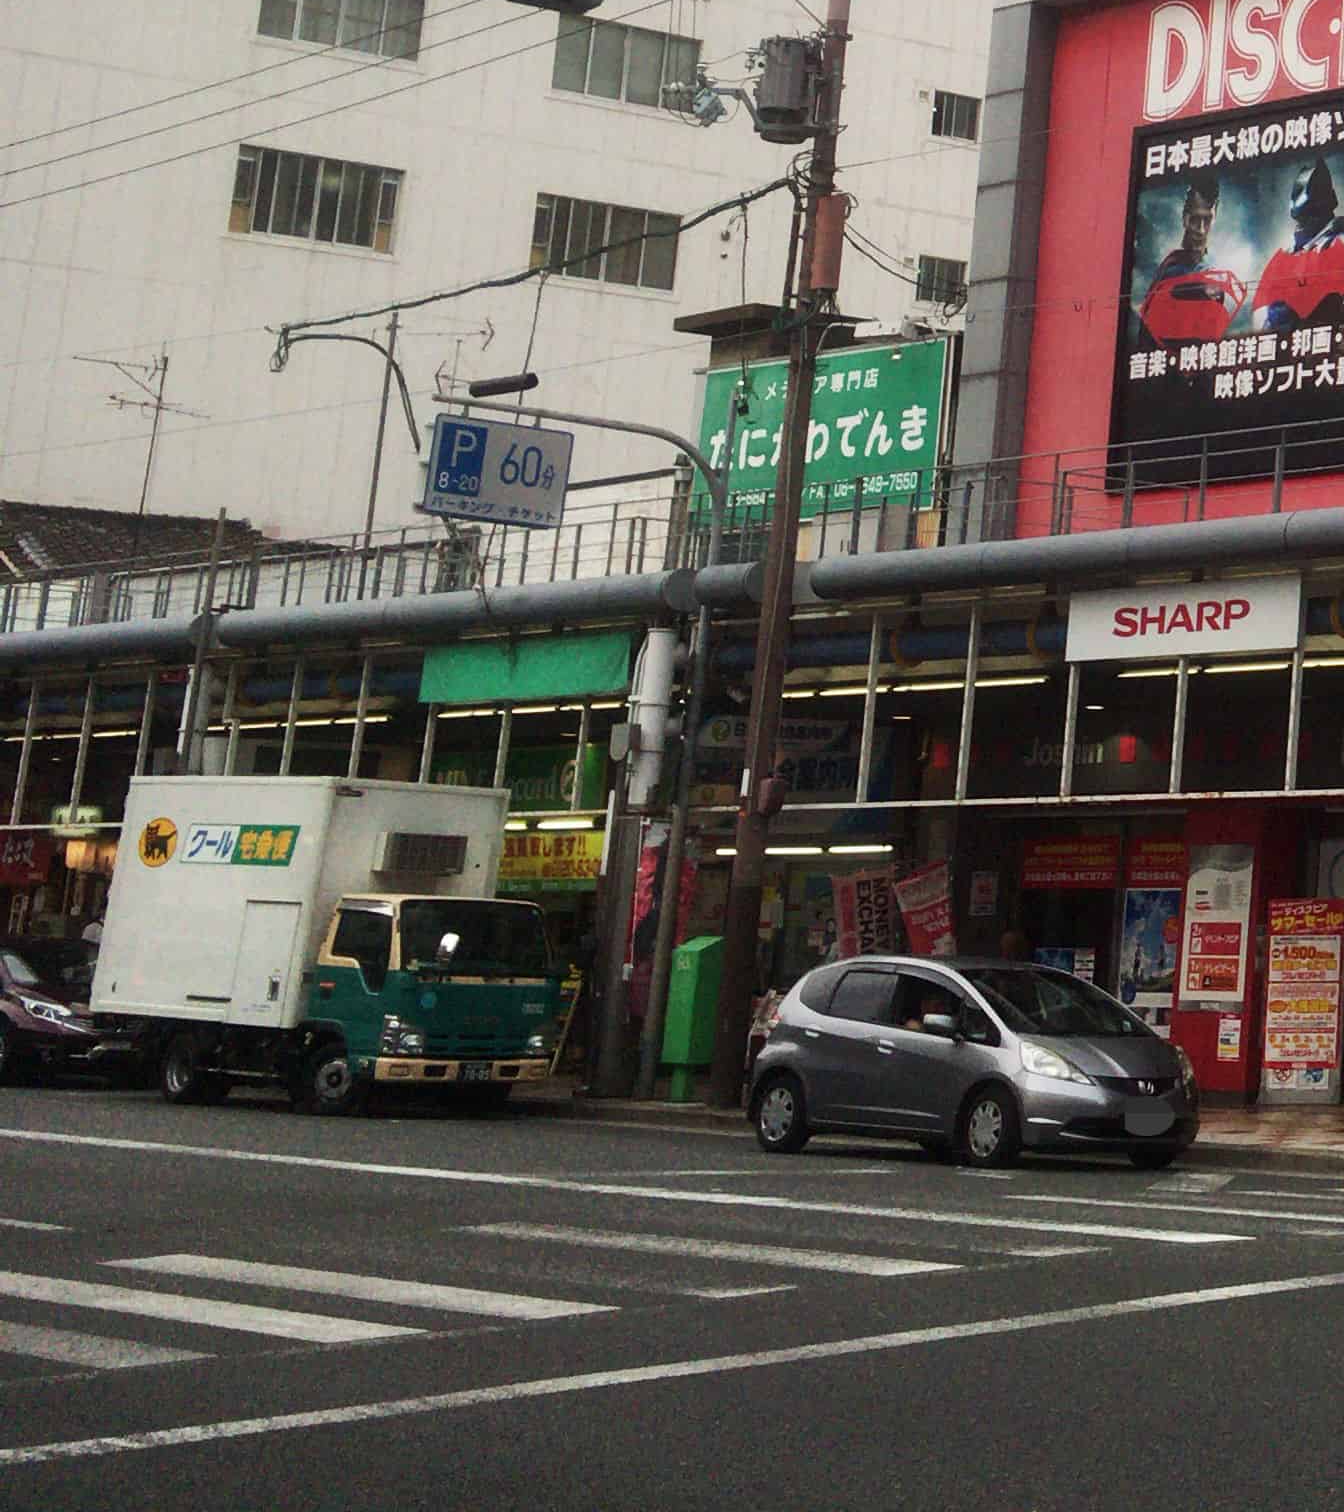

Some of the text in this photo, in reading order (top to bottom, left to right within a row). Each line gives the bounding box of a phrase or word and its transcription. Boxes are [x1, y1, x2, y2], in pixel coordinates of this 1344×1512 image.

[765, 367, 880, 400] メア専門店
[451, 429, 479, 468] P
[1111, 598, 1252, 639] SHARP
[187, 829, 234, 859] クール
